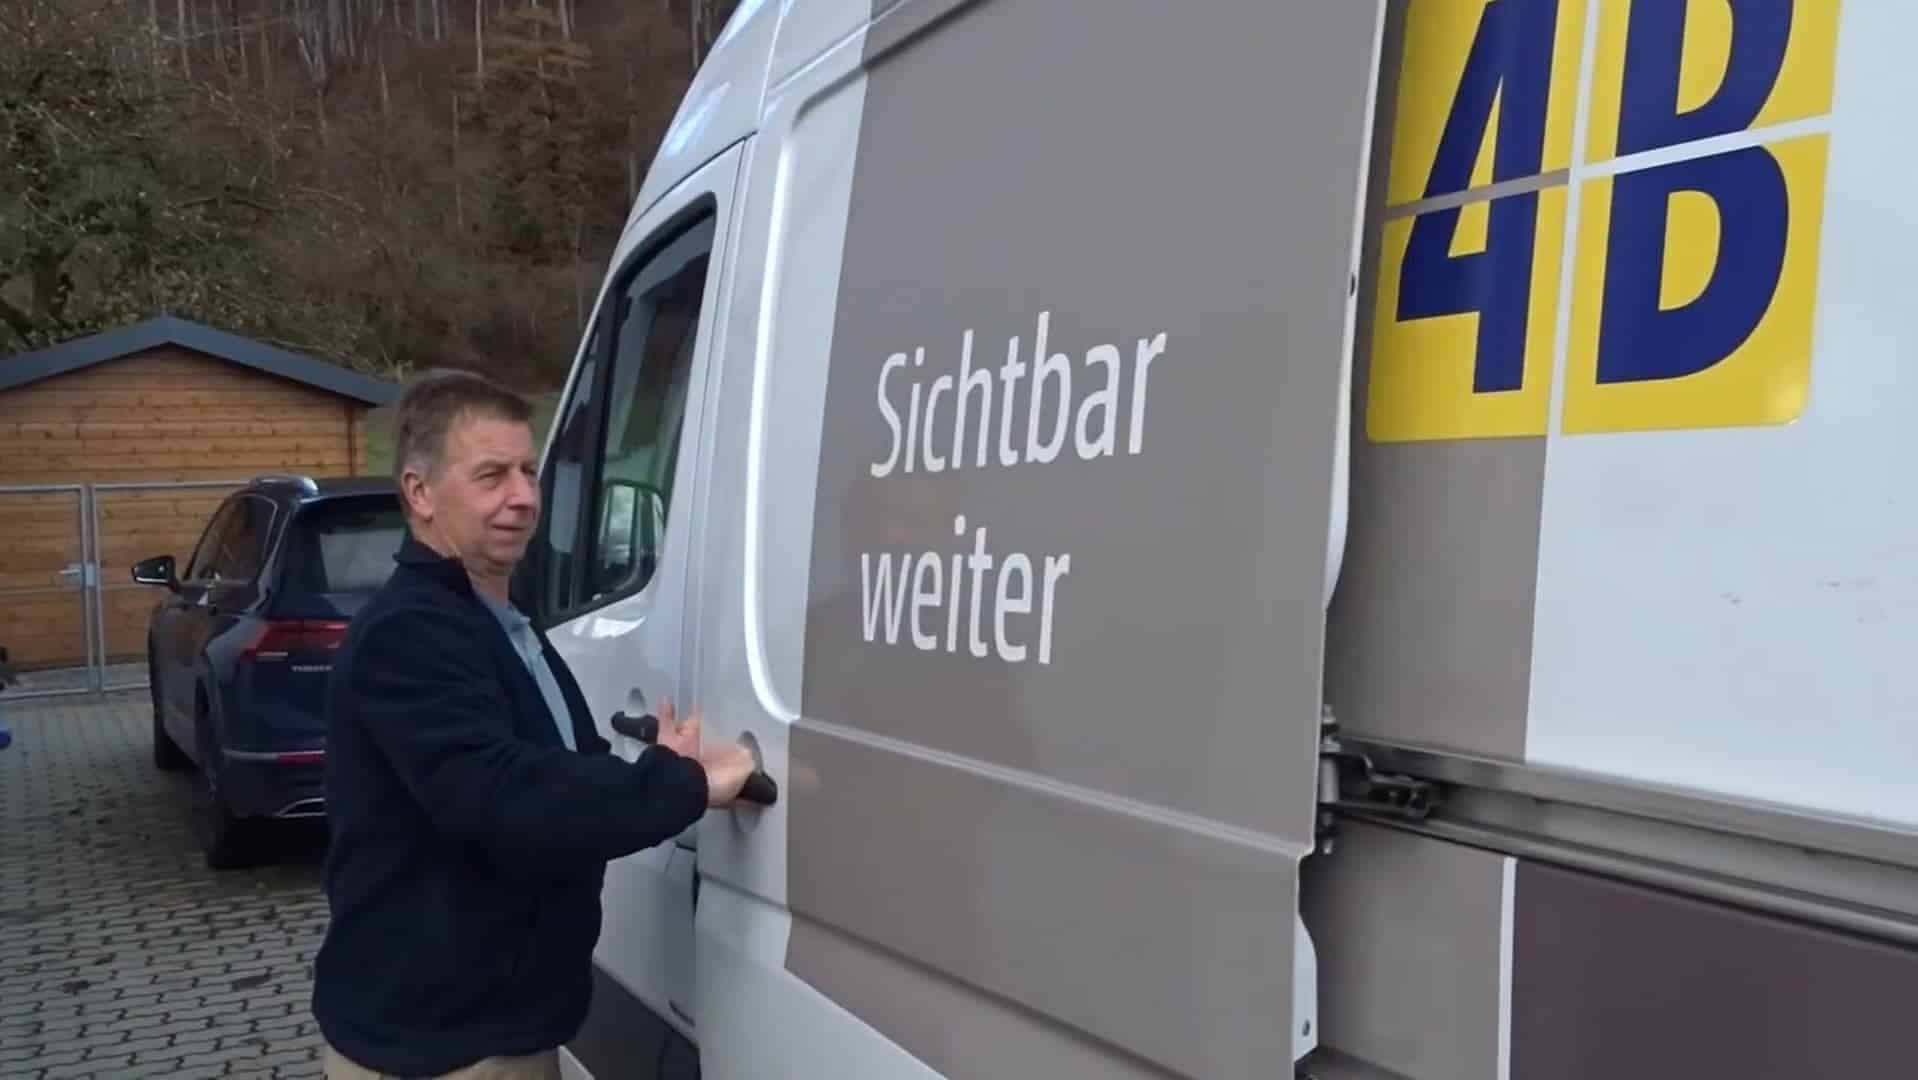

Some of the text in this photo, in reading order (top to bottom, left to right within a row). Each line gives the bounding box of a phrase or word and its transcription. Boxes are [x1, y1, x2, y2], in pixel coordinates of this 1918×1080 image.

[1396, 0, 1794, 394] 4B
[870, 311, 1167, 478] Sichtbar
[861, 514, 1071, 665] weiter
